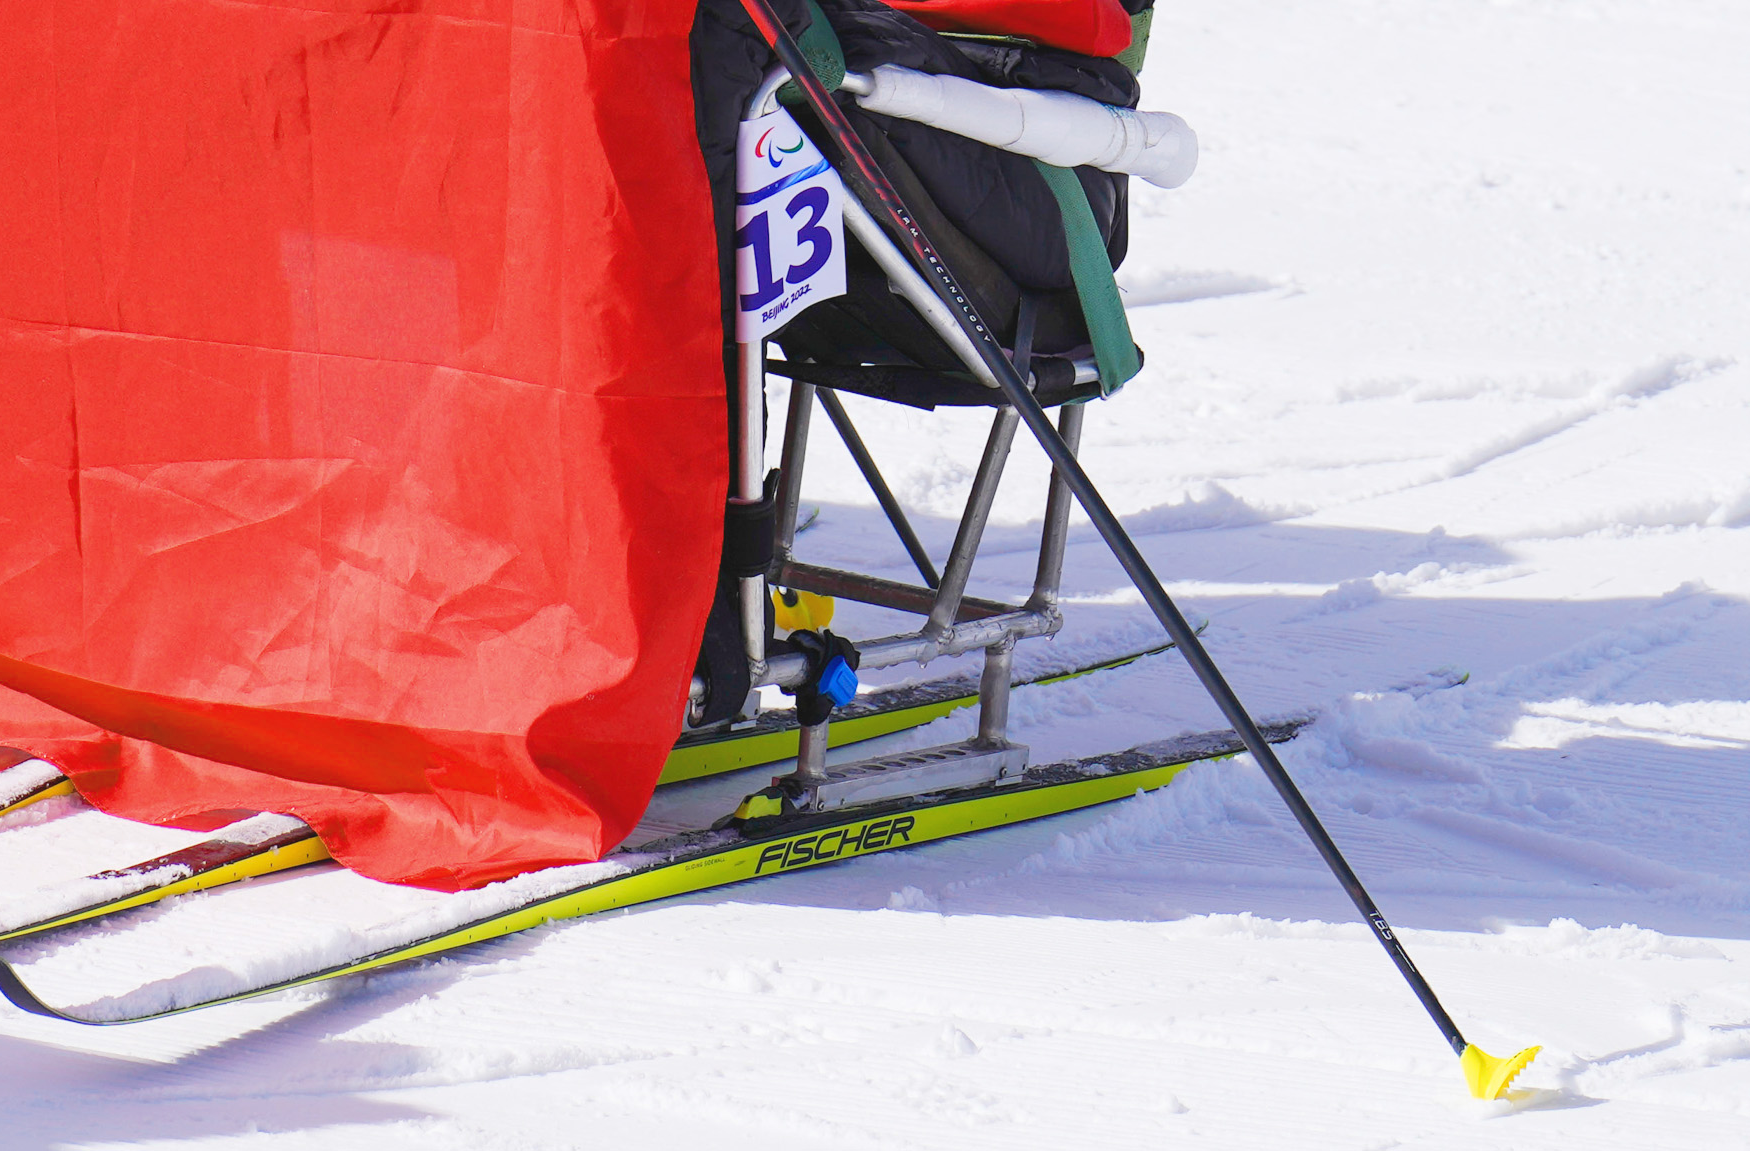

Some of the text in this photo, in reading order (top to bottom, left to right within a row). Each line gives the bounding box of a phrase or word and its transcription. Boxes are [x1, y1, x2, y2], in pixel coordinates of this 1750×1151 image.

[735, 186, 833, 312] 13
[761, 284, 813, 323] BEIJING 2022
[923, 247, 991, 342] TECHNOLOGY
[754, 815, 915, 874] FISCHER
